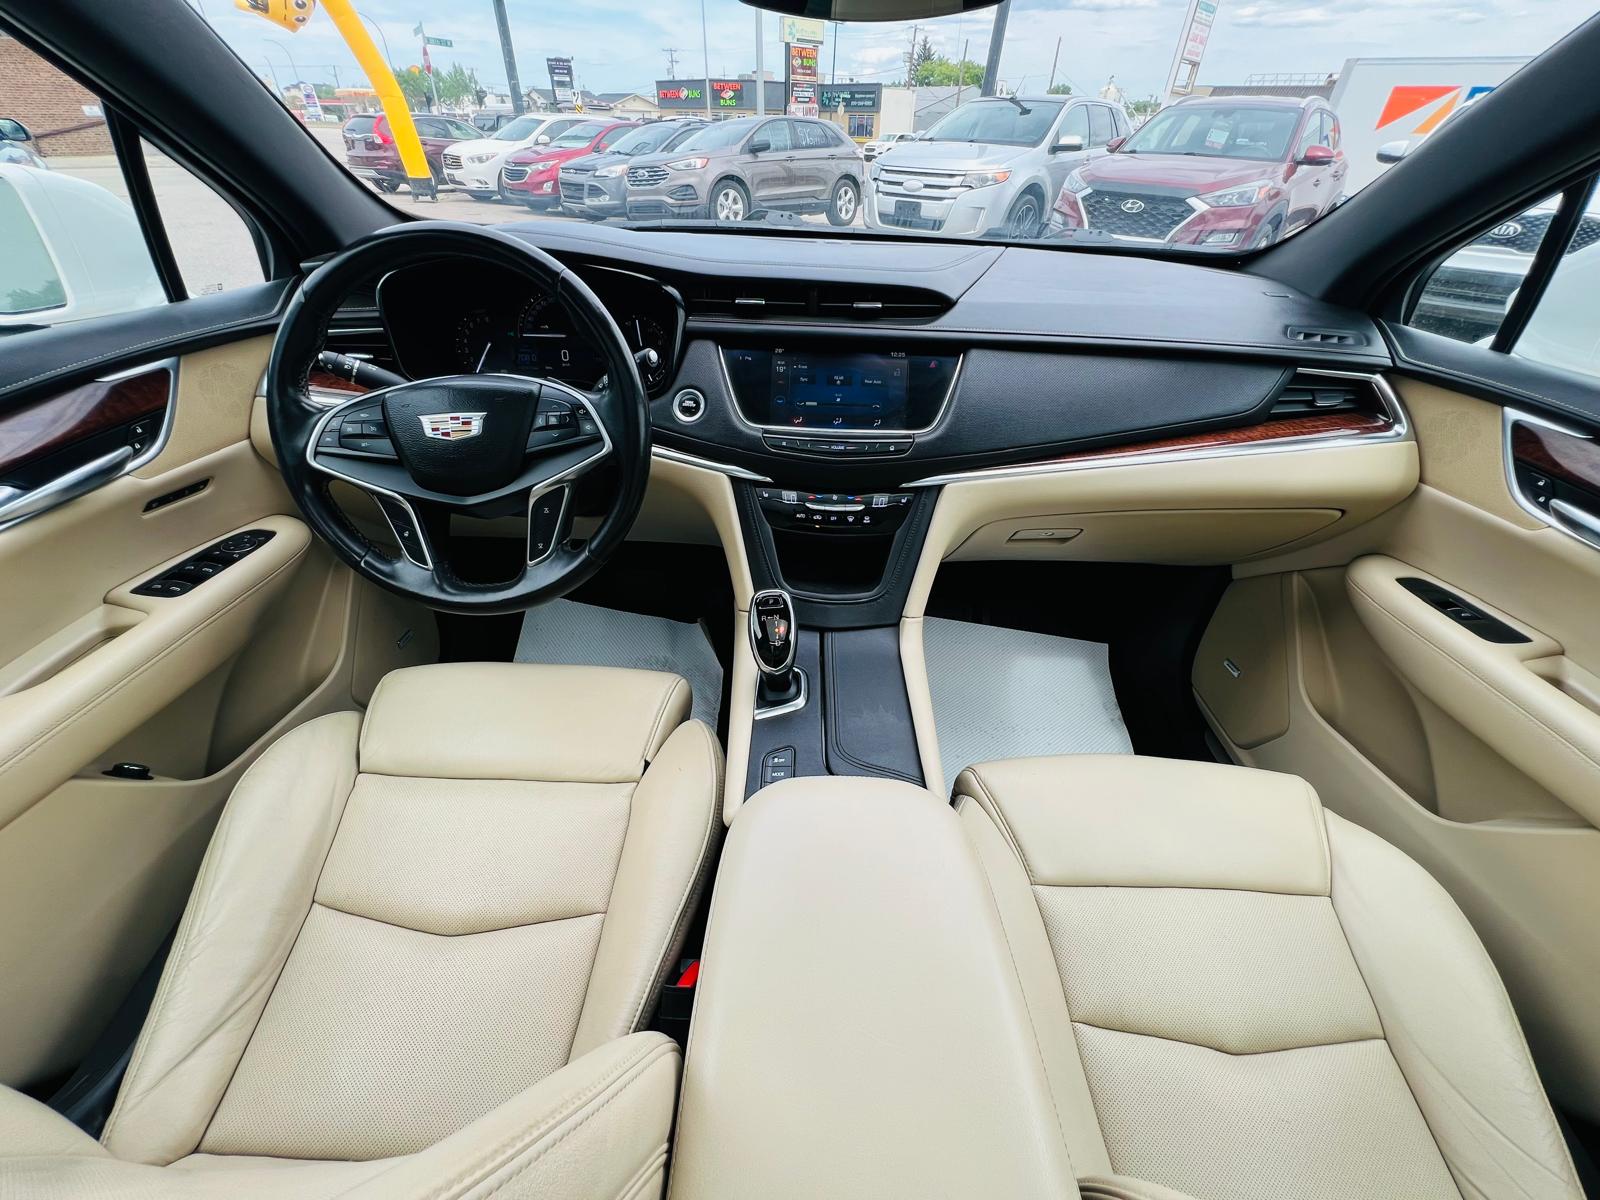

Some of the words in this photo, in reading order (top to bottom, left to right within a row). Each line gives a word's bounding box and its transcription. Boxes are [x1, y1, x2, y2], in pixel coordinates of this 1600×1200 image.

[791, 47, 817, 58] BETWEEN
[803, 58, 817, 67] BUNS
[713, 82, 741, 91] BETWEEN
[659, 89, 680, 98] BETWEEN
[688, 89, 701, 98] BUNS
